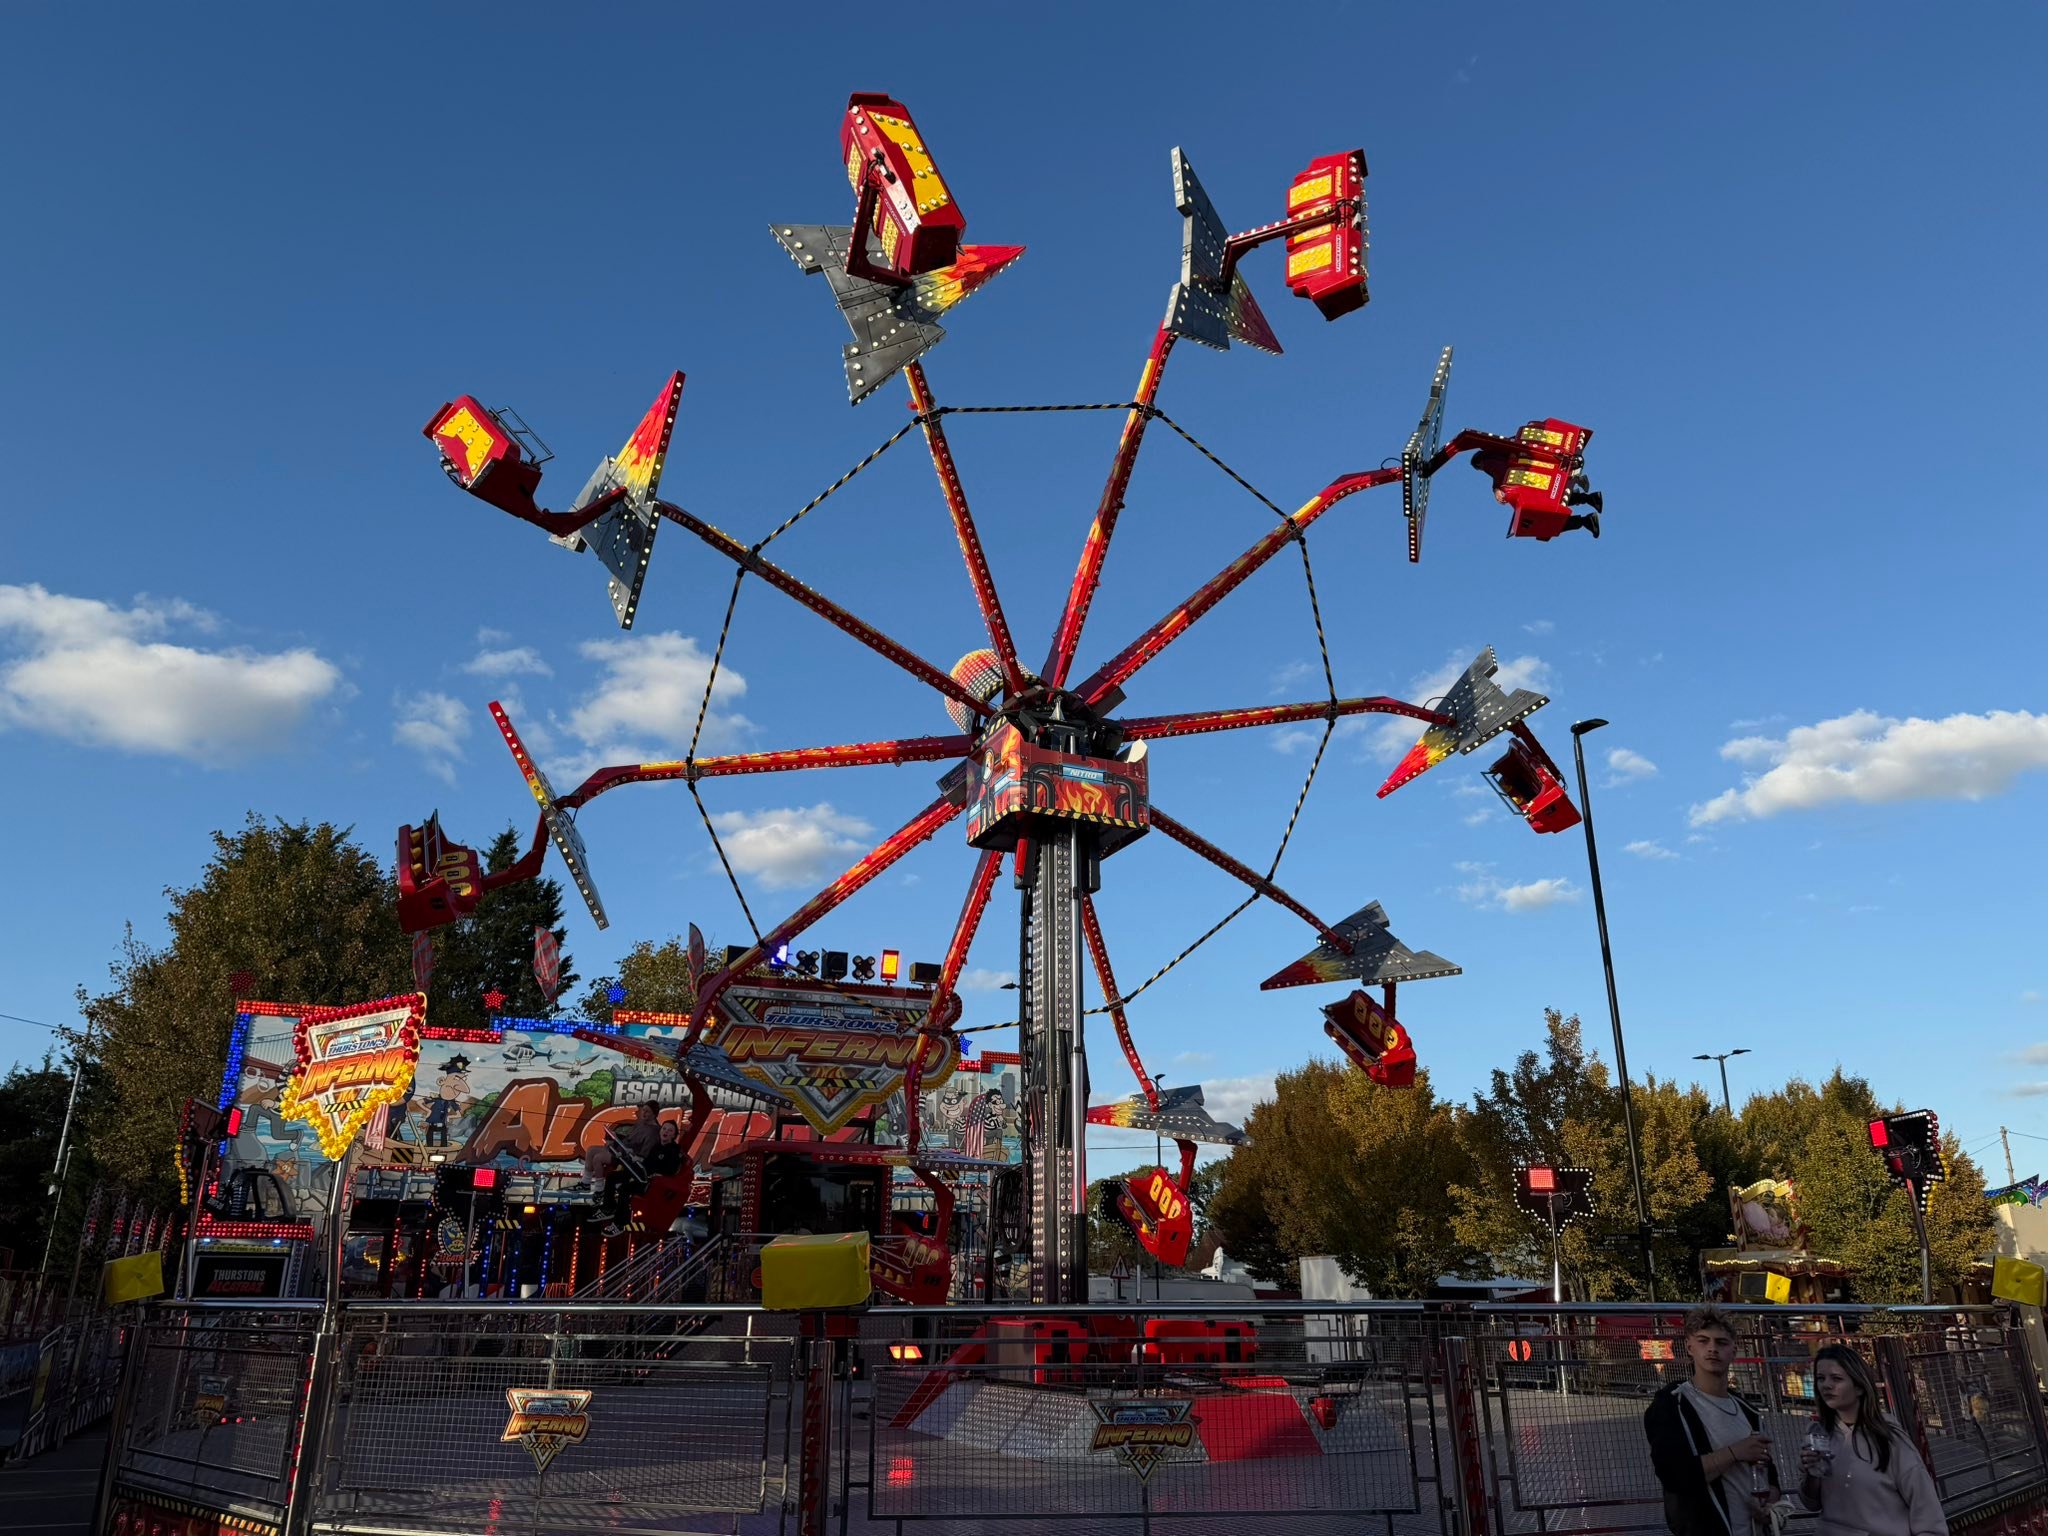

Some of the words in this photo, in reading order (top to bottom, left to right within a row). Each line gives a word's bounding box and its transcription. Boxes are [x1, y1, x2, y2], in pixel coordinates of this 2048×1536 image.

[1070, 768, 1097, 779] NITRO
[764, 1013, 898, 1031] THURSTON'S
[327, 1038, 388, 1056] THURSTON'S
[727, 1026, 944, 1069] INFERNO
[300, 1048, 405, 1099] INFERNO
[613, 1080, 694, 1105] ESCAP
[213, 1269, 266, 1281] THURSTONS
[506, 1413, 586, 1437] INFERNO
[1095, 1424, 1193, 1448] INFERNO
